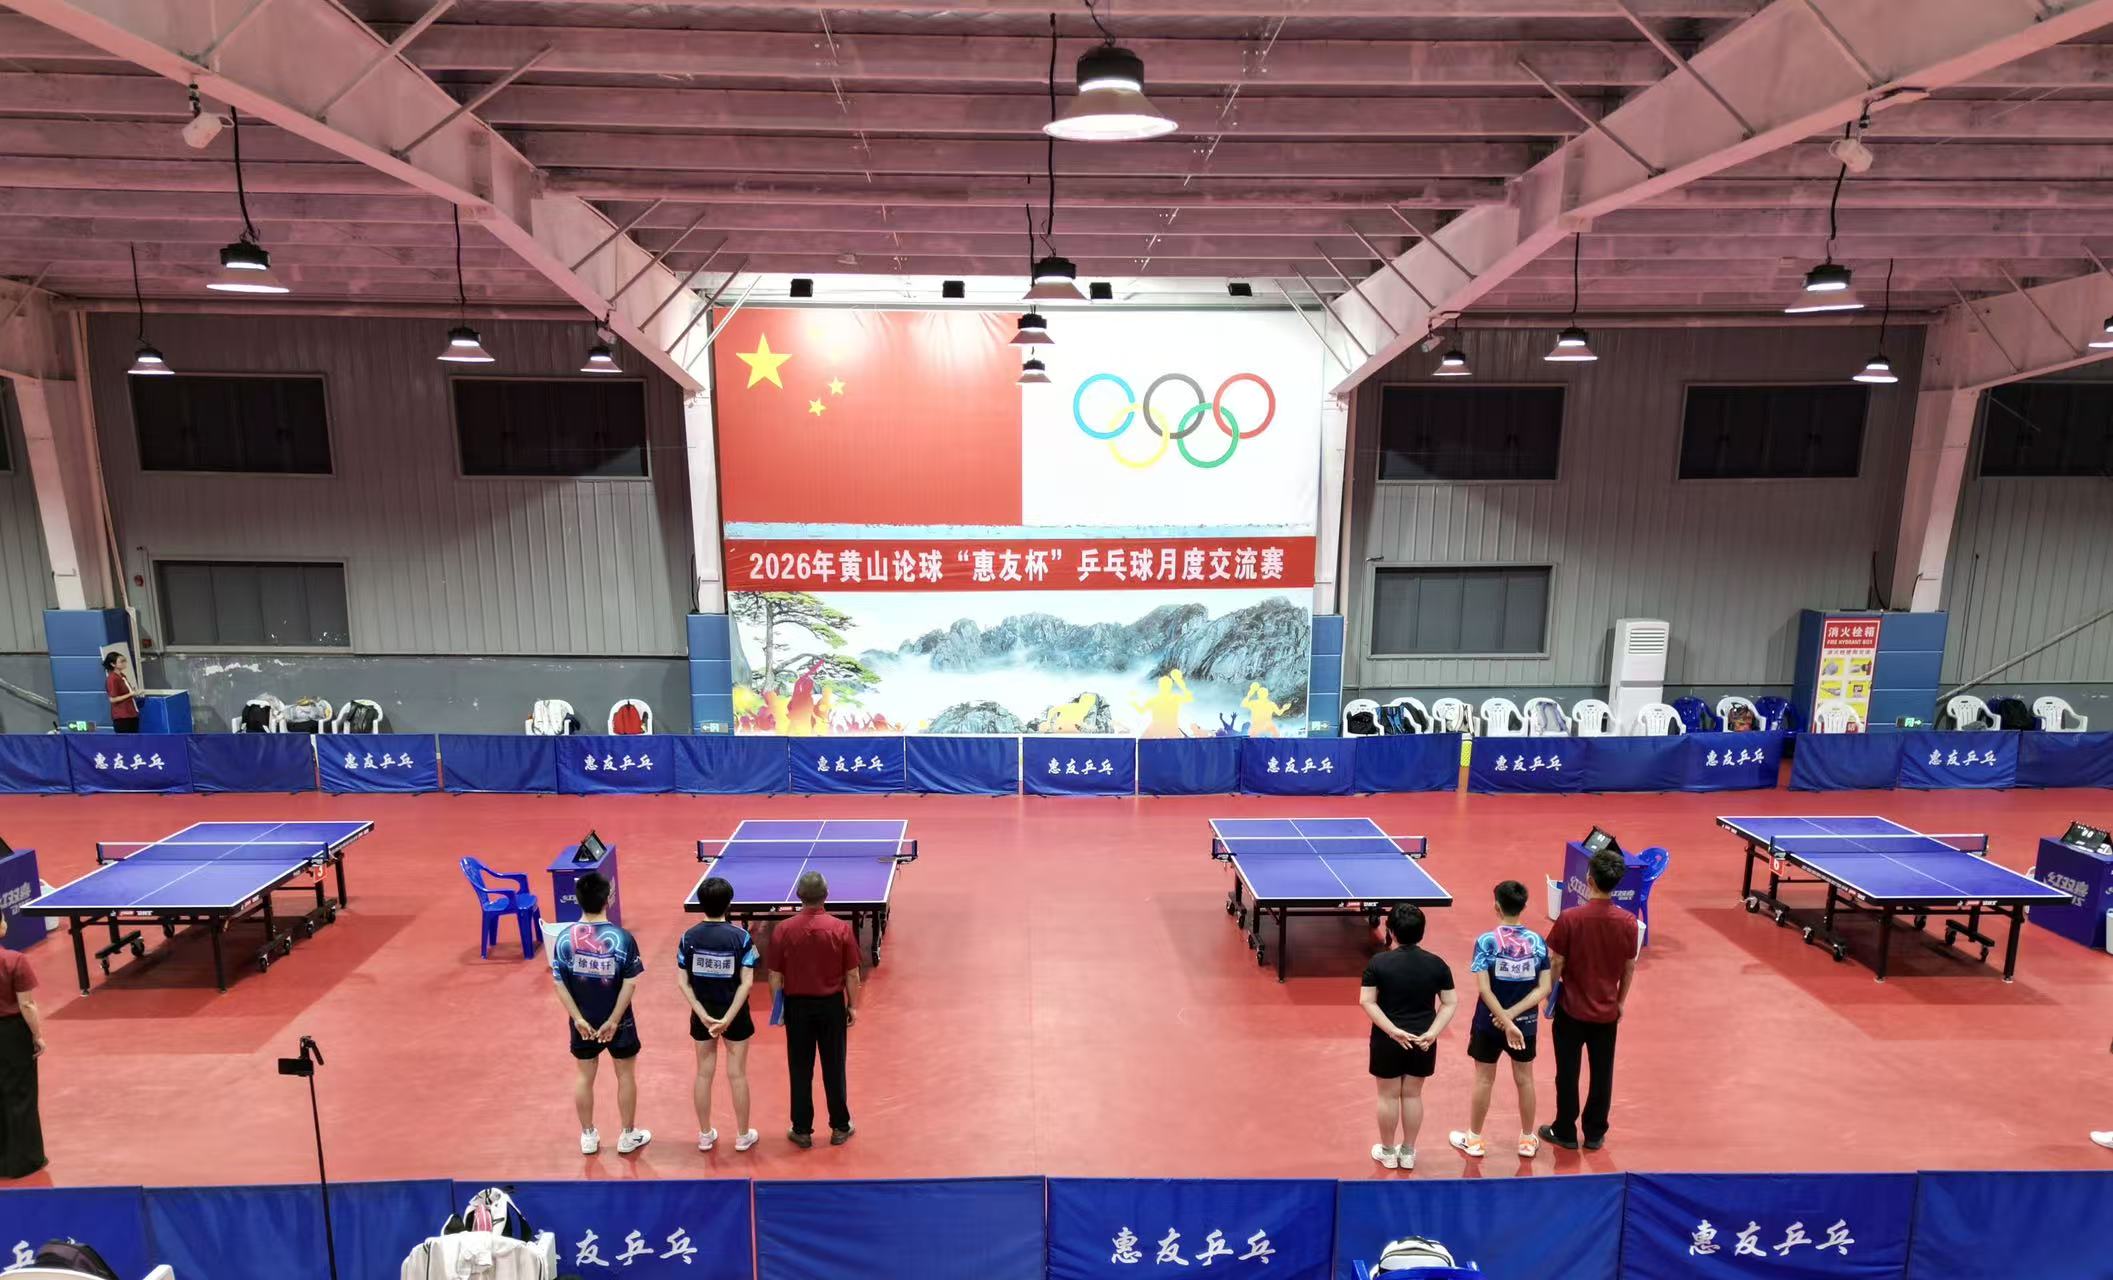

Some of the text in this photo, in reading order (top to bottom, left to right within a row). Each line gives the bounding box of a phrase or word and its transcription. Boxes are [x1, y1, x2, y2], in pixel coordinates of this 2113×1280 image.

[749, 546, 1284, 583] 2026年黄山论球“惠友杯”乒乓球月度交流赛
[1828, 626, 1876, 638] 消火栓箱
[94, 752, 165, 770] 惠友乒乓
[344, 752, 414, 770] 惠友乒乓
[584, 753, 654, 771] 惠友乒乓
[817, 755, 884, 772] 惠友乒乓
[1048, 757, 1114, 775] 惠友乒乓
[1266, 756, 1334, 774] 惠友乒乓
[1494, 754, 1562, 772] 惠友乒乓
[1705, 748, 1765, 767] 惠友乒乓
[1928, 749, 1997, 767] 惠友乒乓
[1111, 1226, 1276, 1266] 惠友乒乓
[1689, 1219, 1855, 1257] 惠友乒乓
[537, 1228, 698, 1267] 友乒乓
